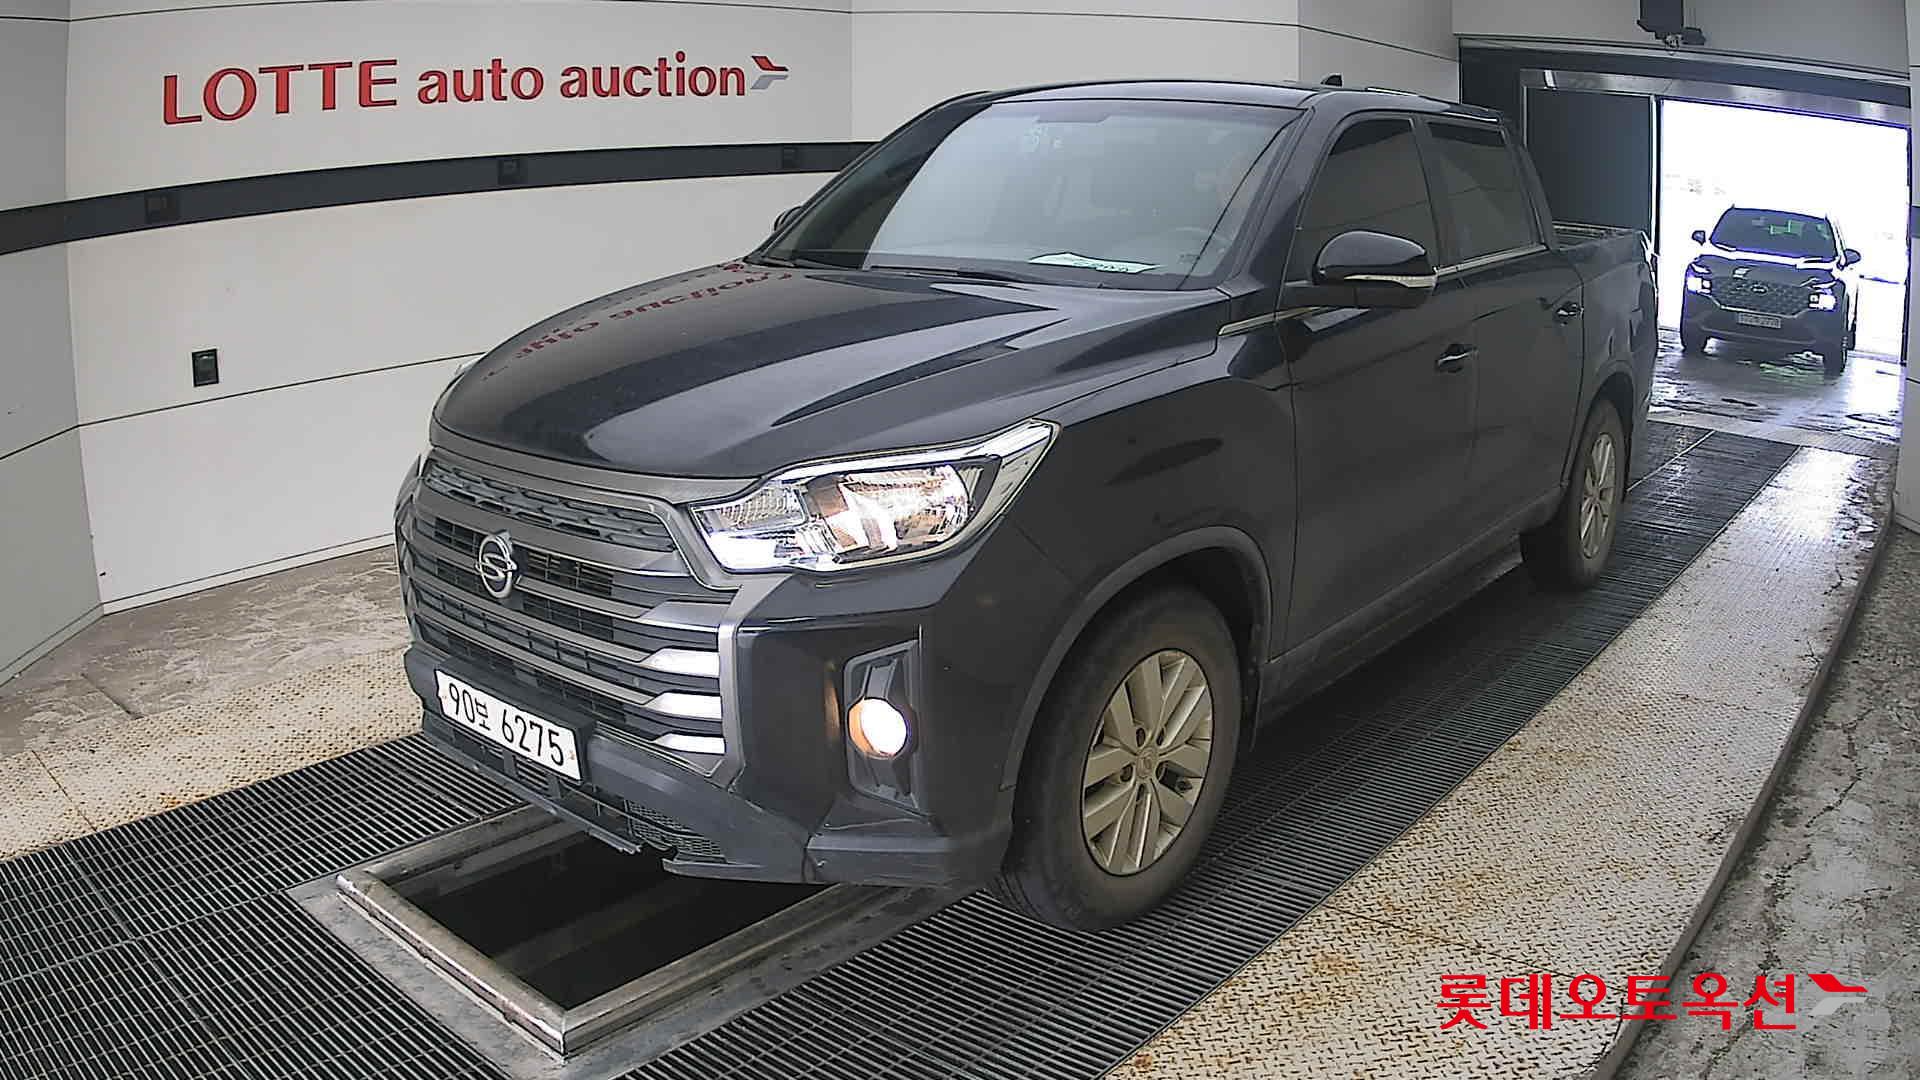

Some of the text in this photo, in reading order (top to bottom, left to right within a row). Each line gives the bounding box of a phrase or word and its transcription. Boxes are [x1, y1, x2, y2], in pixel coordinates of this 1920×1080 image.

[162, 51, 747, 125] LOTTE auto auction
[502, 709, 564, 766] 6275
